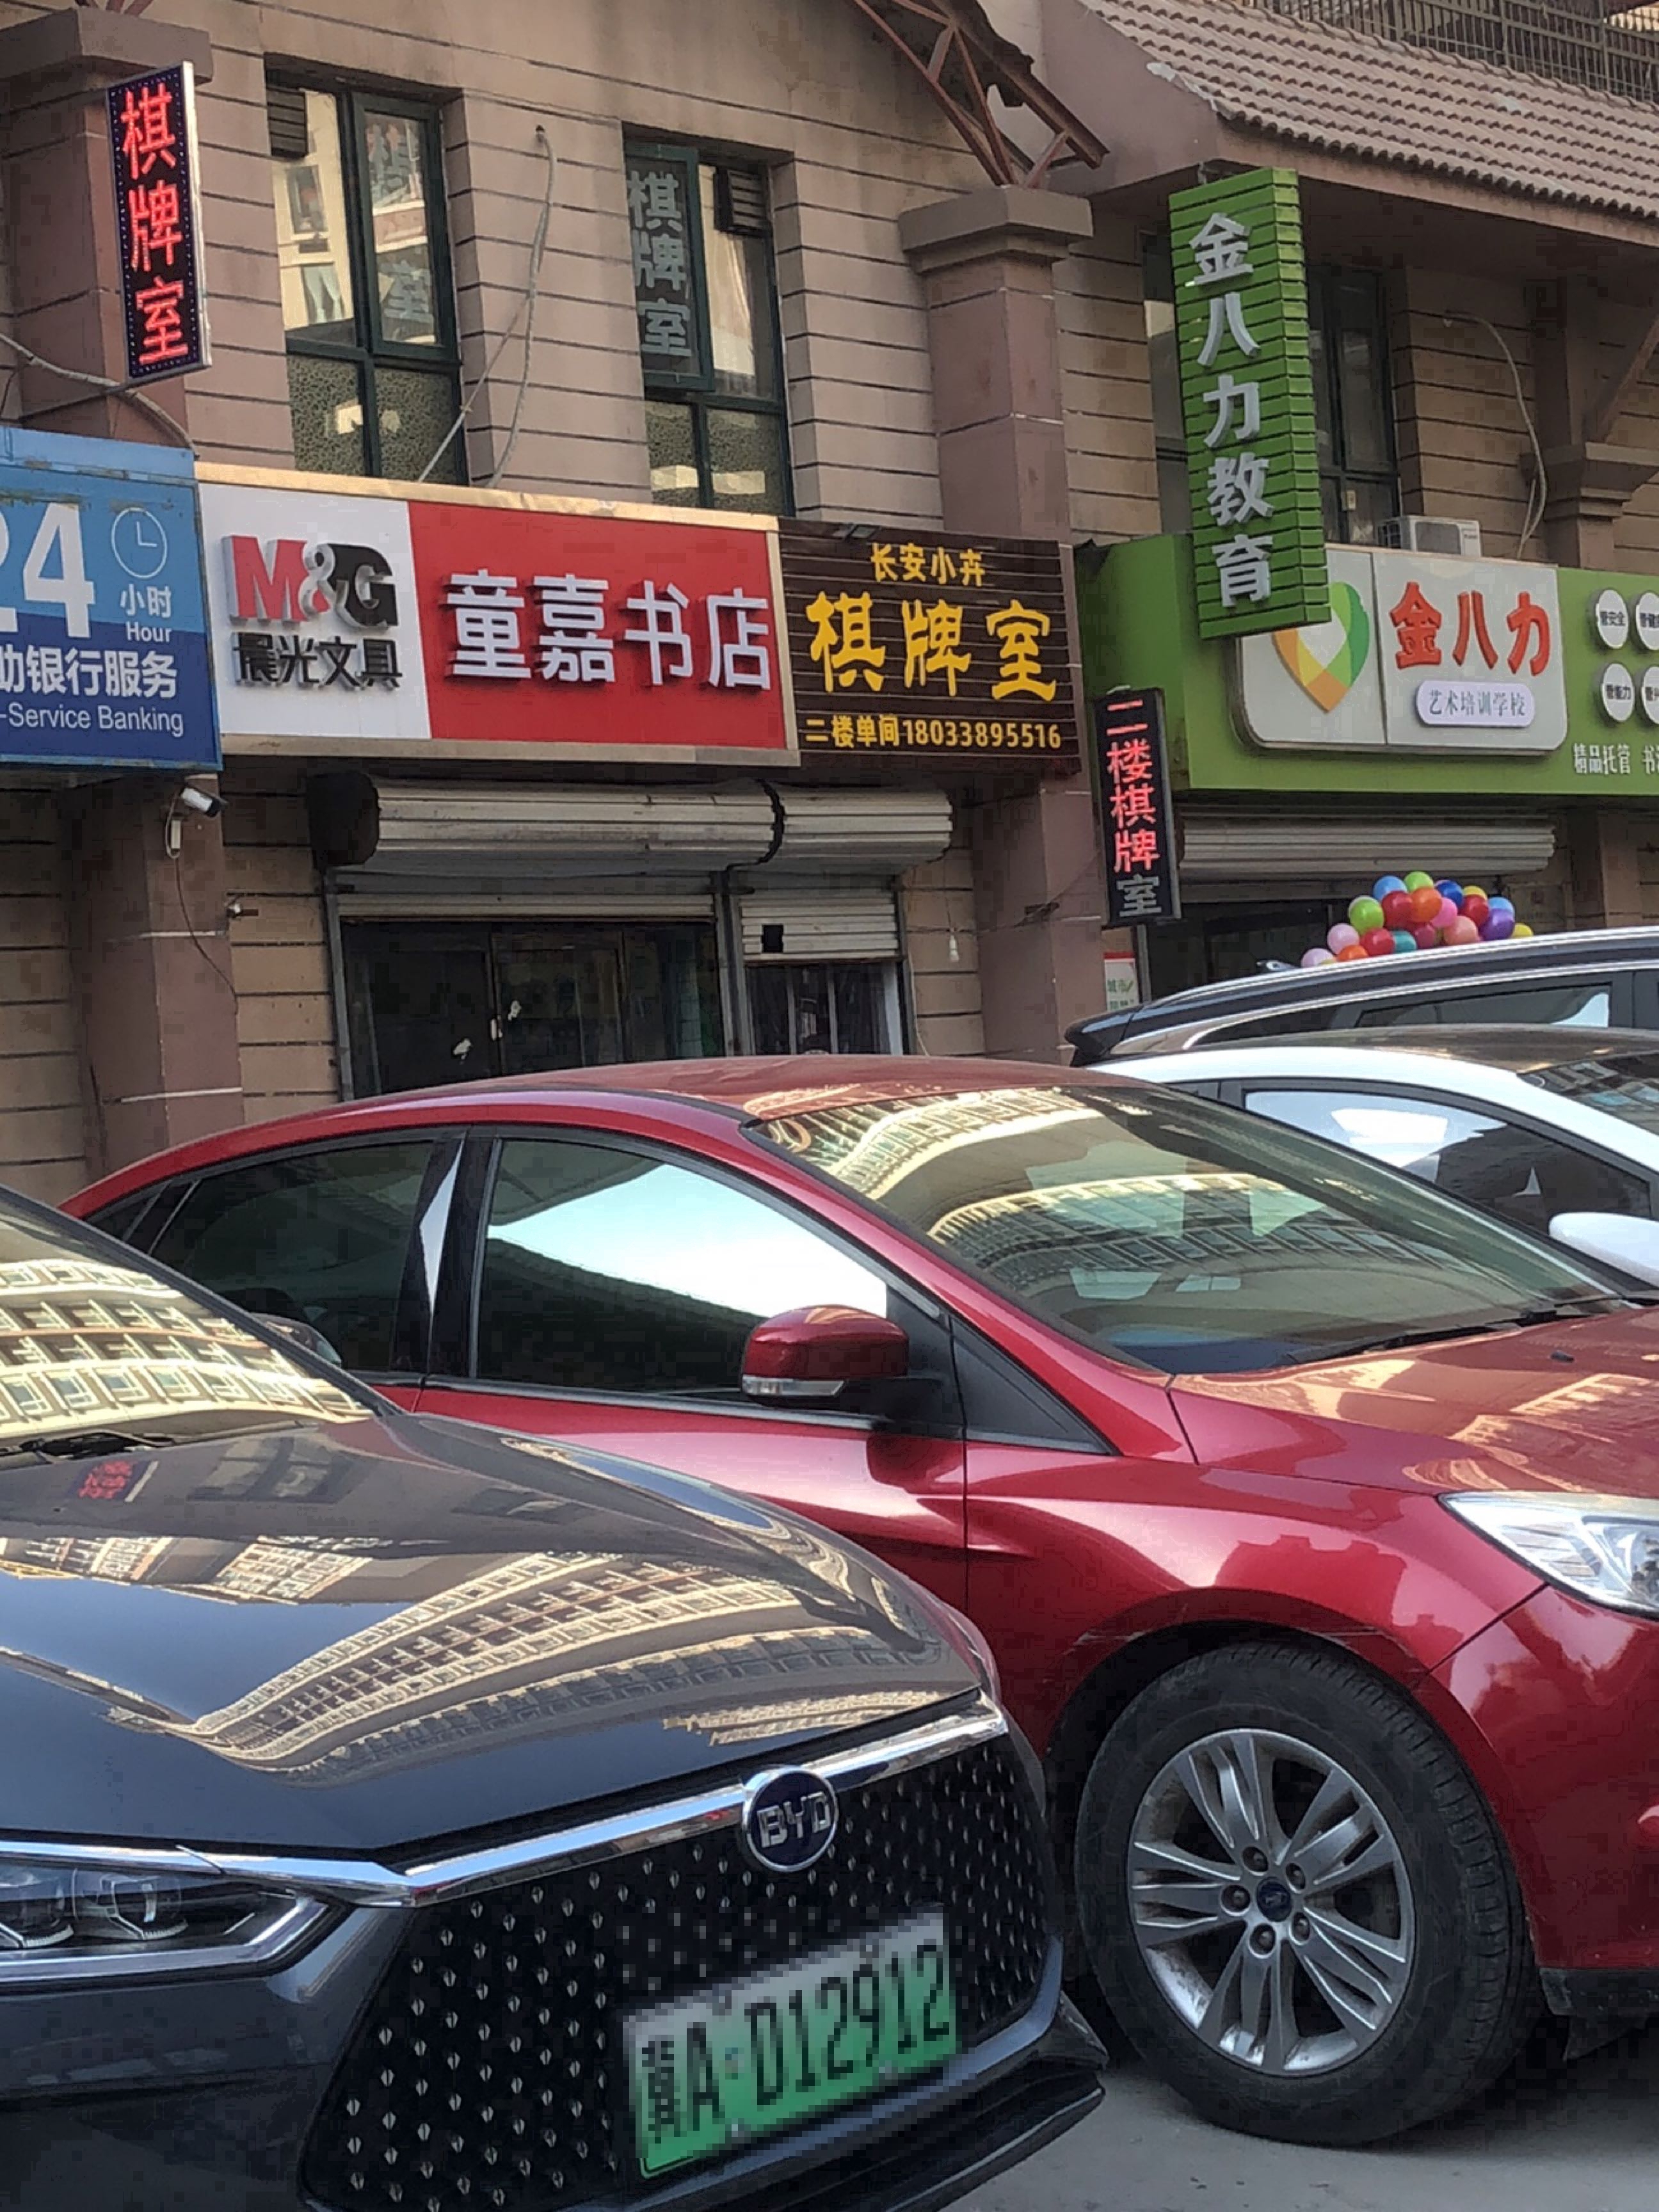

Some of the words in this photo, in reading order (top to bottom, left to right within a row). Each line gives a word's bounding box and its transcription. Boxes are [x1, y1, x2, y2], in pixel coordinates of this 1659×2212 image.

[120, 82, 189, 365] 棋牌室
[627, 170, 692, 357] 棋牌室
[1189, 212, 1275, 608] 金八力教育
[0, 502, 95, 638] 4
[120, 583, 172, 618] 小时
[221, 534, 398, 628] M&G
[126, 621, 172, 642] Hour
[233, 630, 403, 689] 晨光文具
[447, 569, 770, 690] 童嘉书店
[806, 591, 1056, 701] 棋牌室
[1390, 581, 1551, 676] 金八力
[97, 705, 184, 738] Banking
[806, 714, 899, 748] 二楼单间
[902, 719, 1062, 749] 18033895516
[1429, 689, 1526, 717] 艺术培训学校
[1106, 700, 1162, 918] 二楼棋牌室
[757, 1792, 831, 1848] BYD
